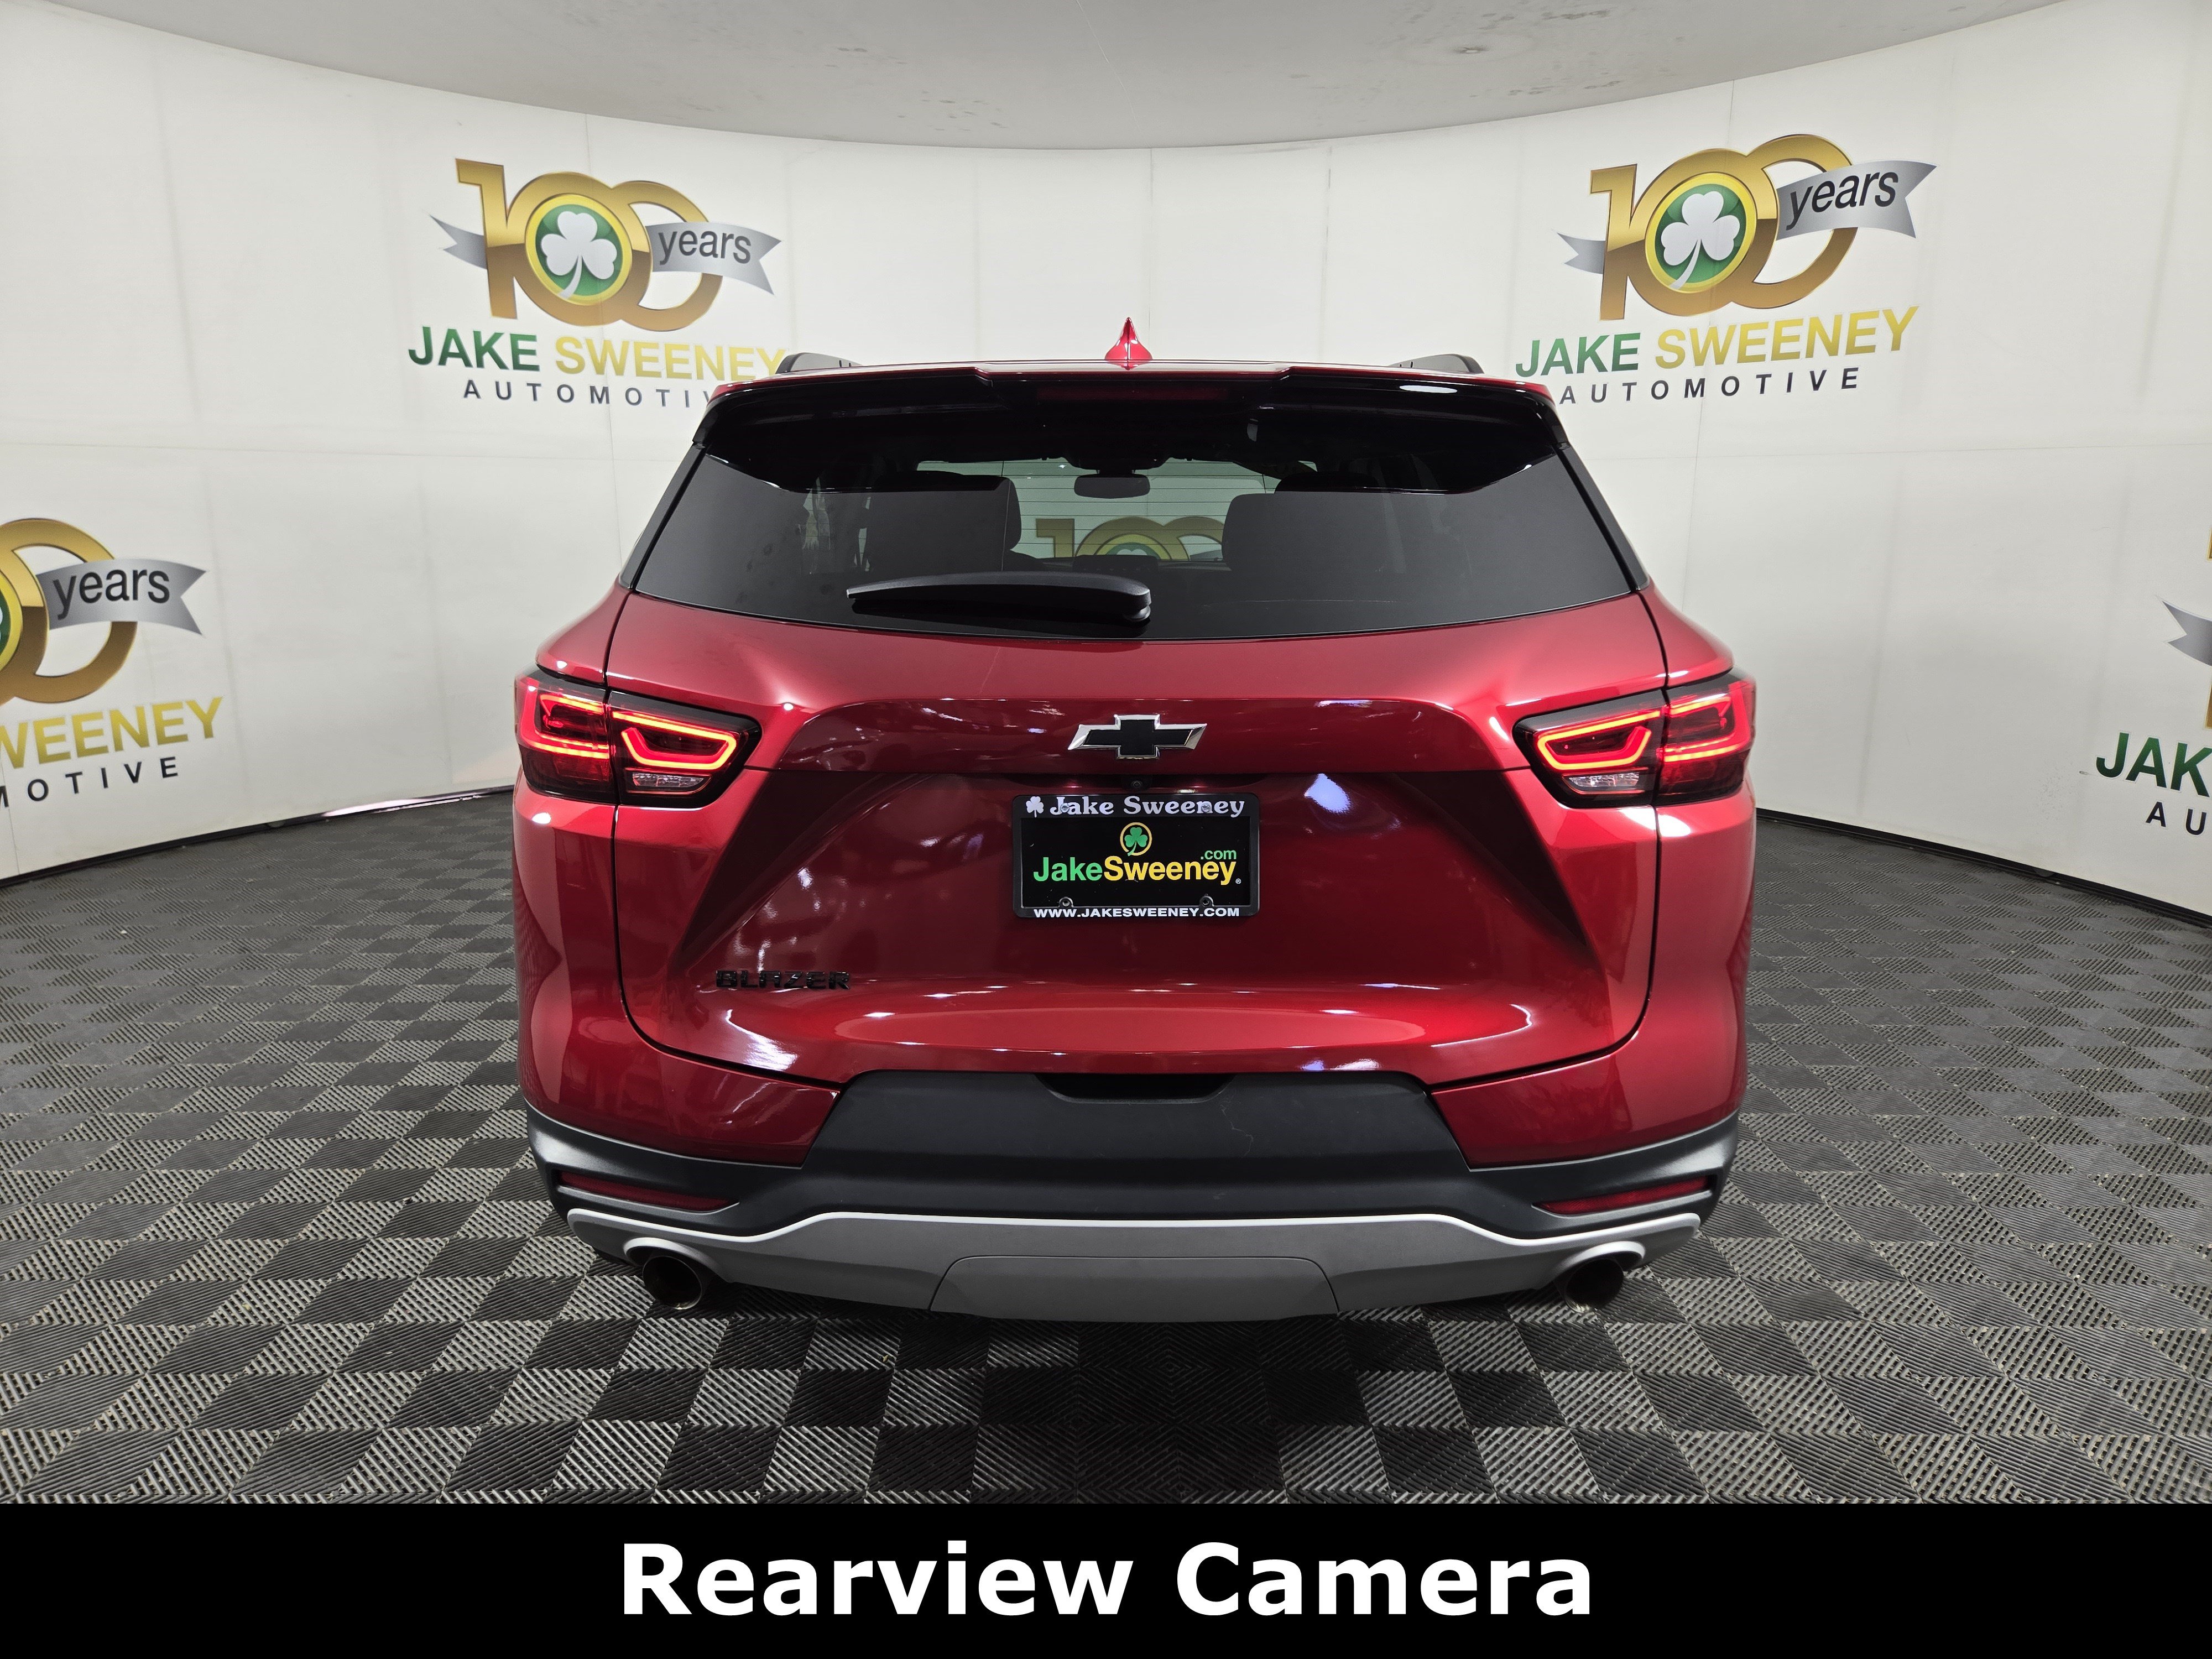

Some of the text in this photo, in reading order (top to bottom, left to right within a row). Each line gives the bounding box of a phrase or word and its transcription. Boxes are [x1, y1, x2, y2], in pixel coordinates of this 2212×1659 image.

[1787, 170, 1900, 229] years
[455, 158, 723, 331] 100
[659, 229, 752, 265] years
[1590, 134, 1858, 321] 100
[408, 326, 786, 381] JAKE SWEENEY
[1516, 306, 1920, 377] JAKE SWEENEY
[1559, 367, 1859, 404] AUTOMOTIVE
[53, 569, 170, 620] years
[1050, 796, 1245, 817] Jake Sweeney
[1034, 907, 1239, 917] WWW.JAKESWEENEY.COM
[716, 970, 850, 989] BLAZER
